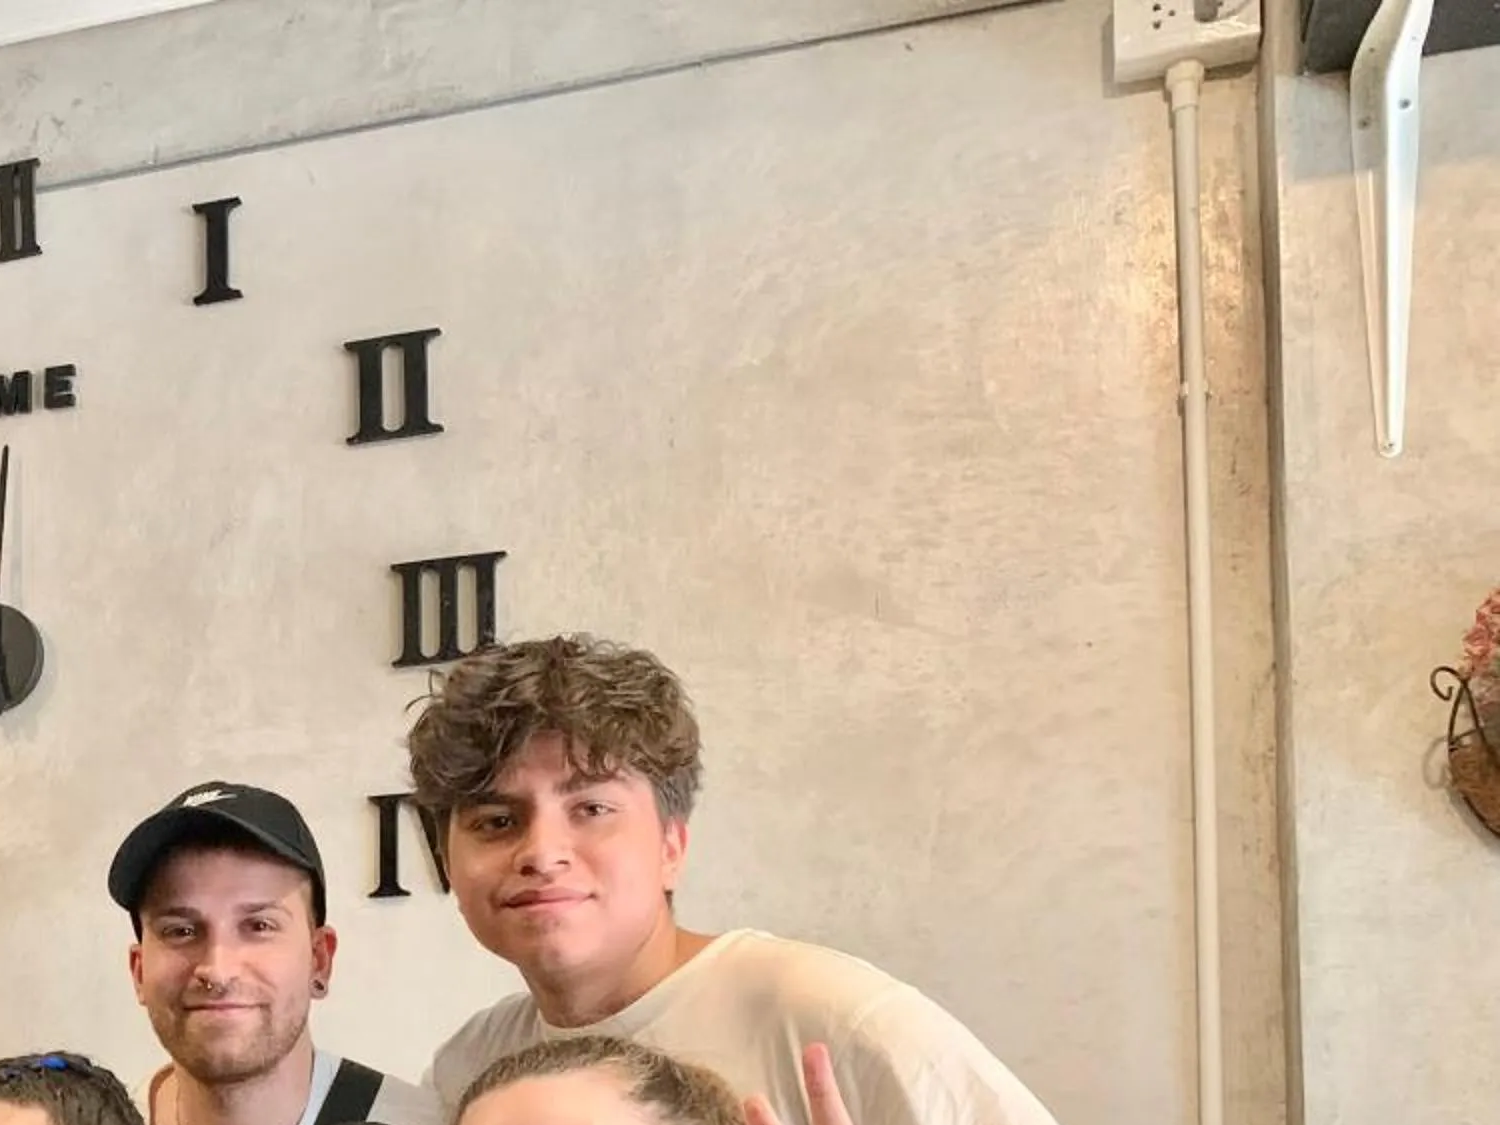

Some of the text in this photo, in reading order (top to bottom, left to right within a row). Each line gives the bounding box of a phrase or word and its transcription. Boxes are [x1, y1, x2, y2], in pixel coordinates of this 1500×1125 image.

[192, 196, 243, 307] I
[343, 327, 444, 446] II
[390, 550, 507, 667] III
